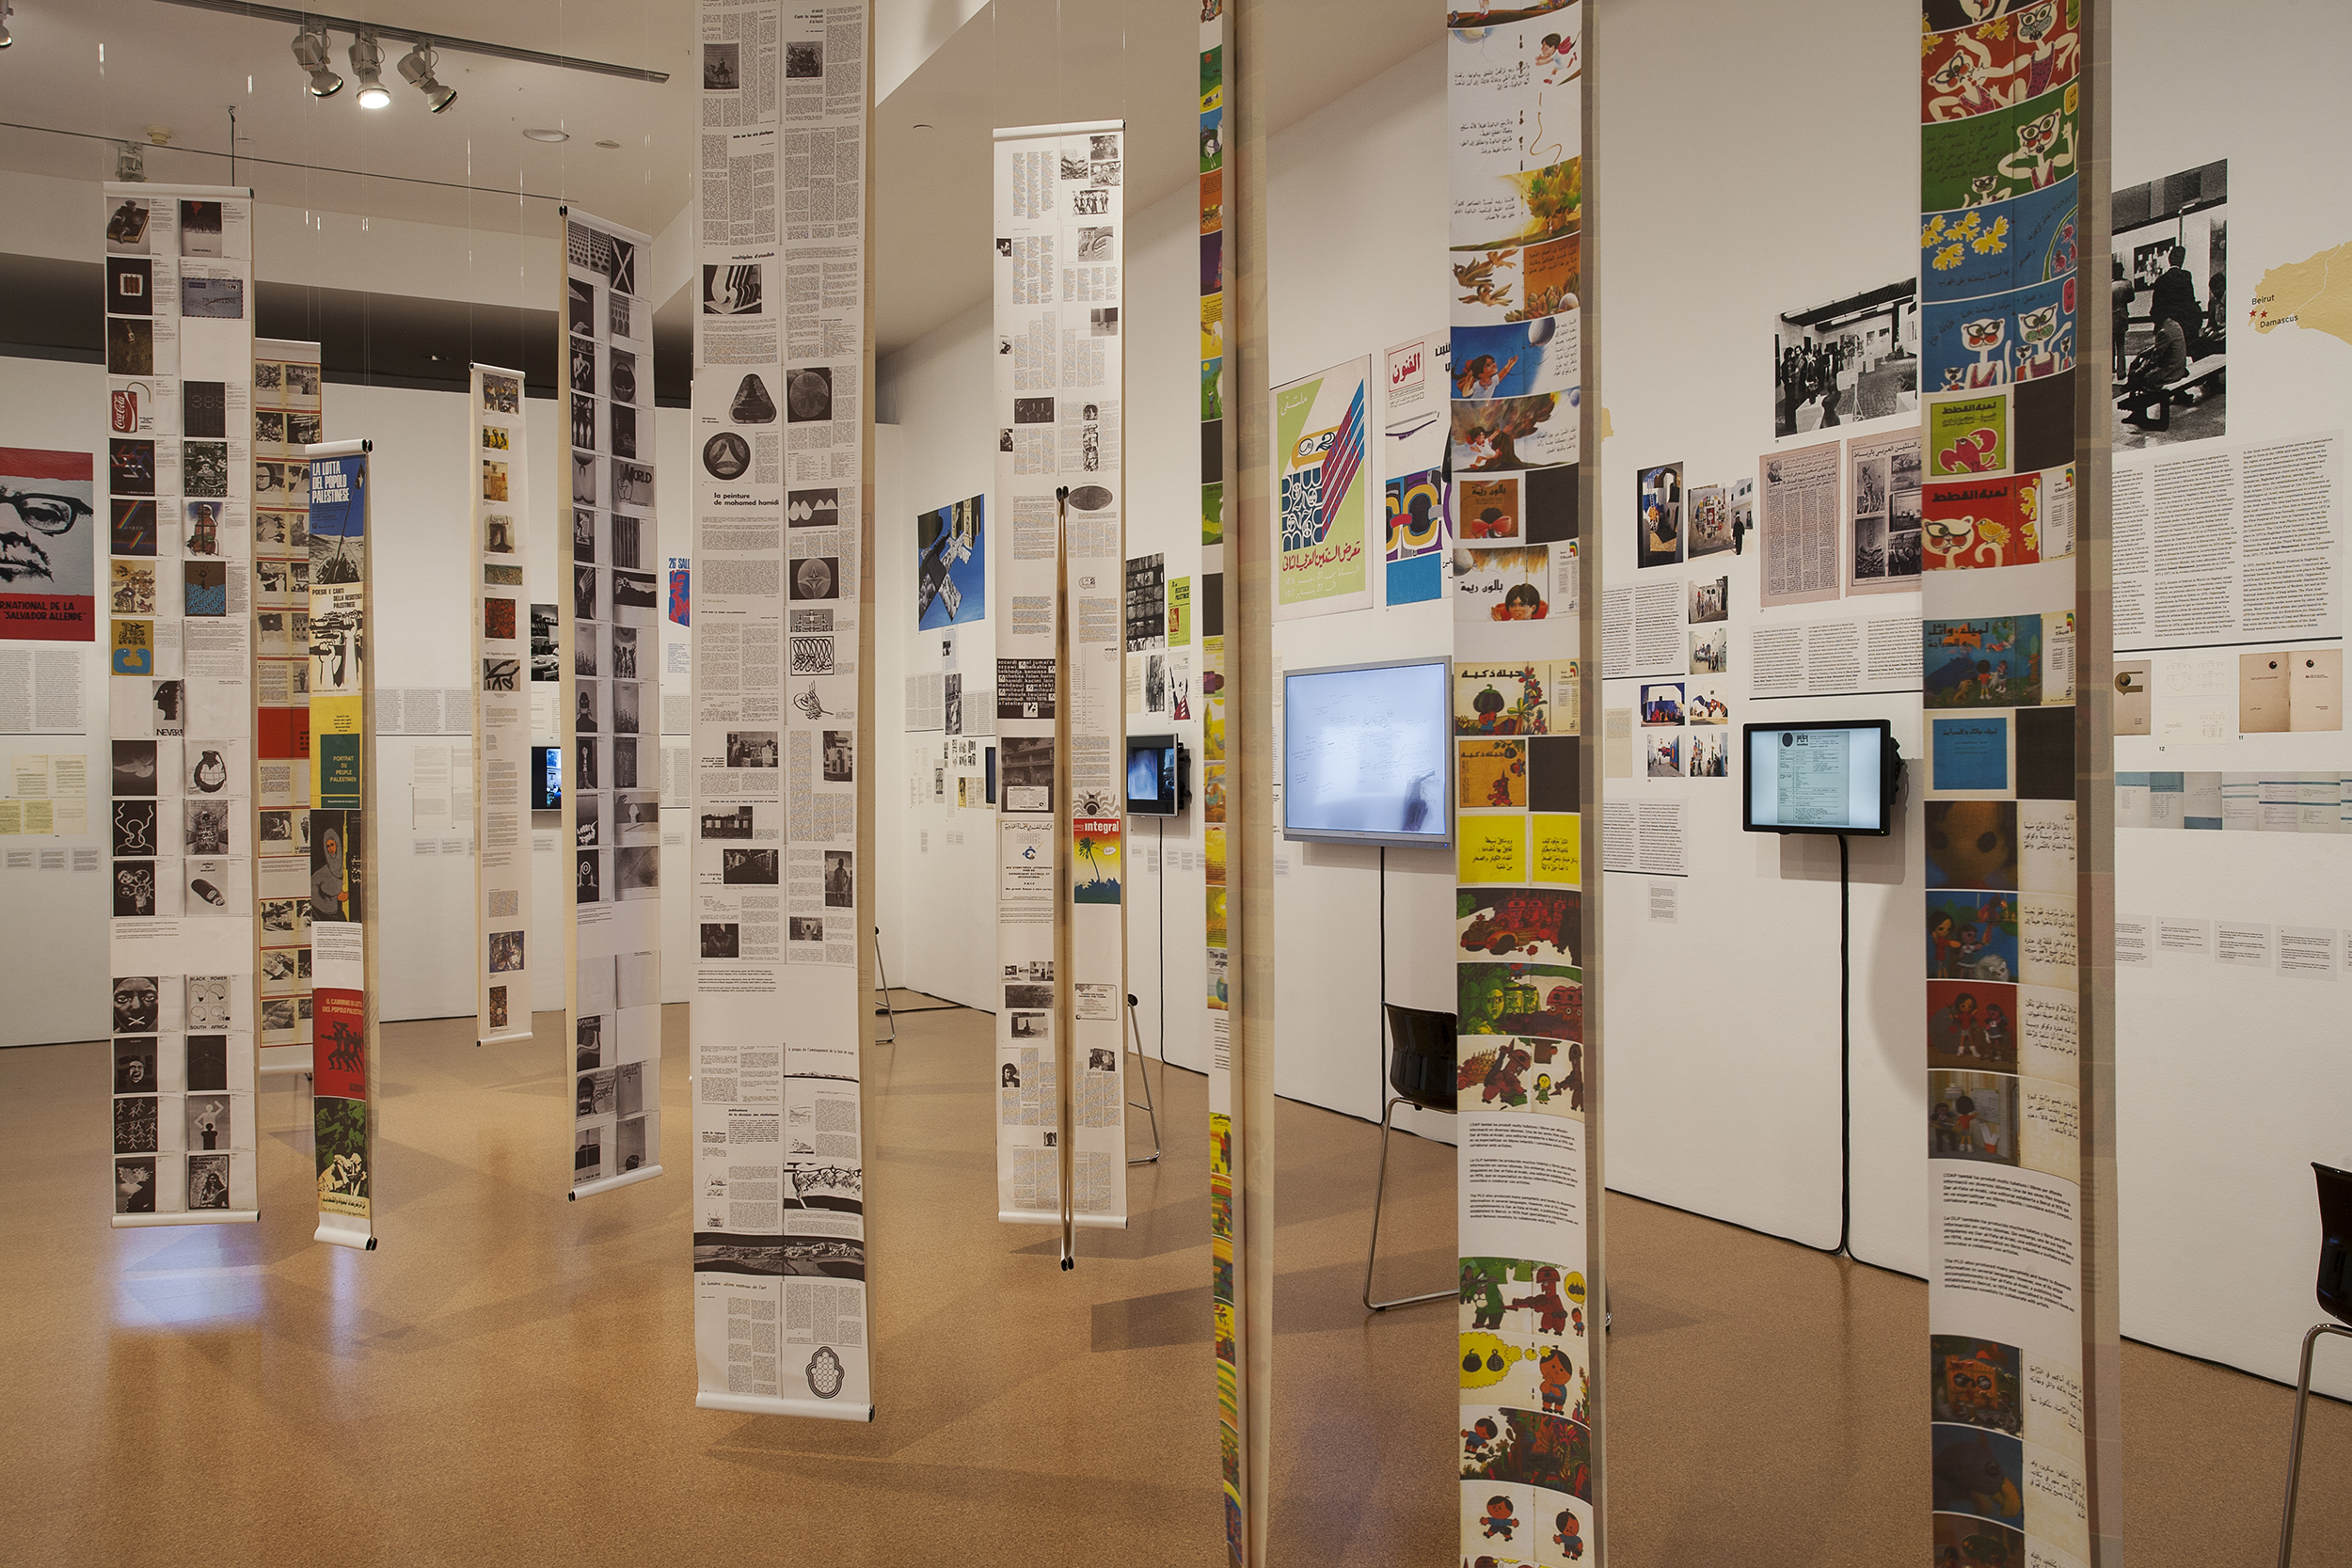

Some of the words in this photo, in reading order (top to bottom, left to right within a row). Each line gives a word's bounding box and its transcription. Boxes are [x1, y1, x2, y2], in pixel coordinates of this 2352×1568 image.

[2252, 294, 2275, 305] Beirut
[2260, 315, 2298, 328] Damascus
[1393, 352, 1420, 384] الفنون
[1281, 392, 1307, 416] ملتقى
[1942, 405, 1974, 414] القطط
[312, 462, 320, 476] LA
[322, 461, 341, 475] LOTTA
[312, 476, 323, 490] DEL
[325, 474, 347, 489] POPOLO
[312, 488, 349, 503] PALESTINESE
[1932, 489, 1978, 502] القطط
[1315, 545, 1340, 568] السنتين
[1339, 541, 1361, 562] معرض
[1296, 548, 1317, 571] العربي
[1460, 579, 1479, 593] ريمة
[1482, 580, 1503, 593] بالون
[0, 601, 47, 610] RNATIONAL
[50, 602, 60, 610] DE
[63, 602, 74, 610] LA
[3, 610, 47, 620] "SALVADOR
[49, 611, 86, 621] ALLENDE"
[1085, 821, 1119, 834] integral
[1017, 833, 1041, 844] BMCE
